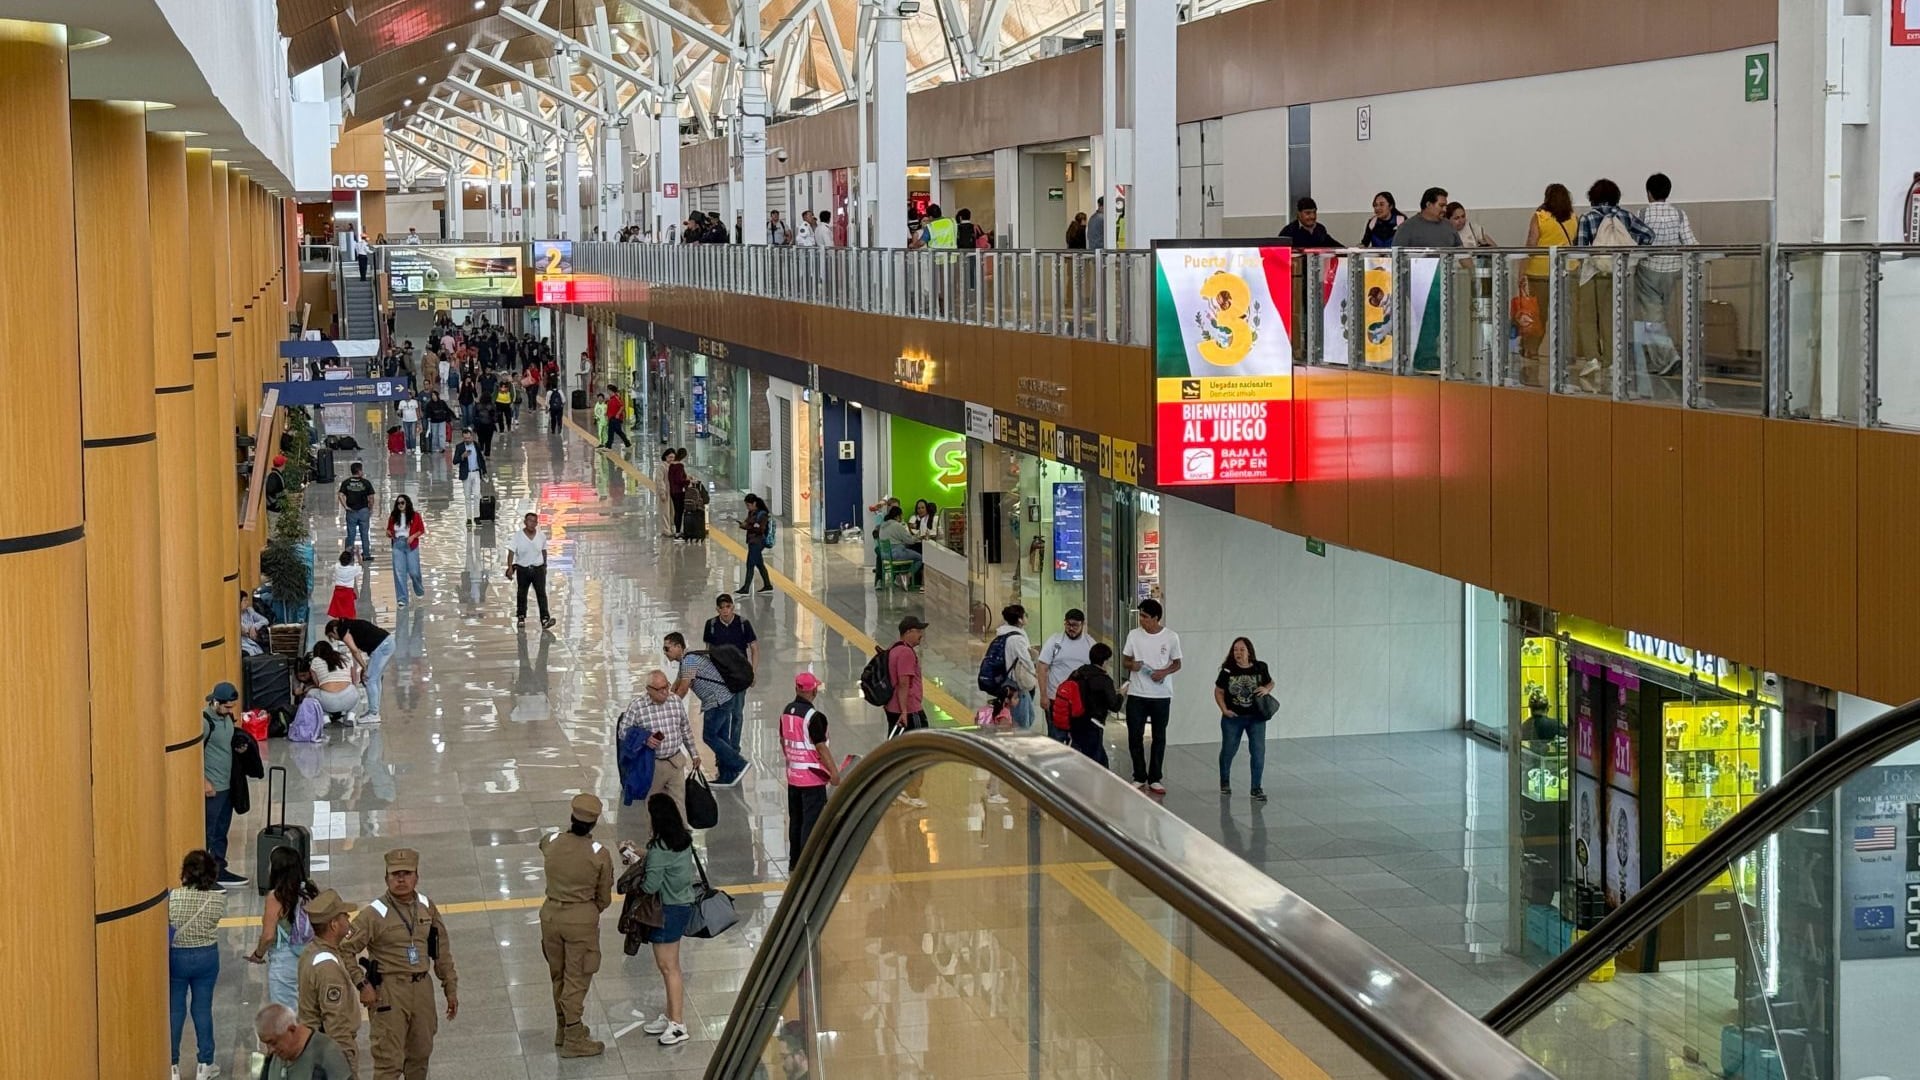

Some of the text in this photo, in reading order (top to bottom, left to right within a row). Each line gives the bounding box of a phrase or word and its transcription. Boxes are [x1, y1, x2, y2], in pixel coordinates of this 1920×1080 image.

[546, 247, 562, 274] 2
[1184, 255, 1227, 268] Puerta
[1197, 271, 1251, 366] 3
[1239, 380, 1273, 388] nacionales
[1183, 402, 1267, 420] BIENVENIDOS
[1183, 419, 1267, 442] AL JUEGO
[1100, 443, 1111, 472] B1
[1221, 447, 1267, 458] BAJA LA
[1220, 458, 1267, 469] APP EN
[1615, 736, 1630, 774] 3x1
